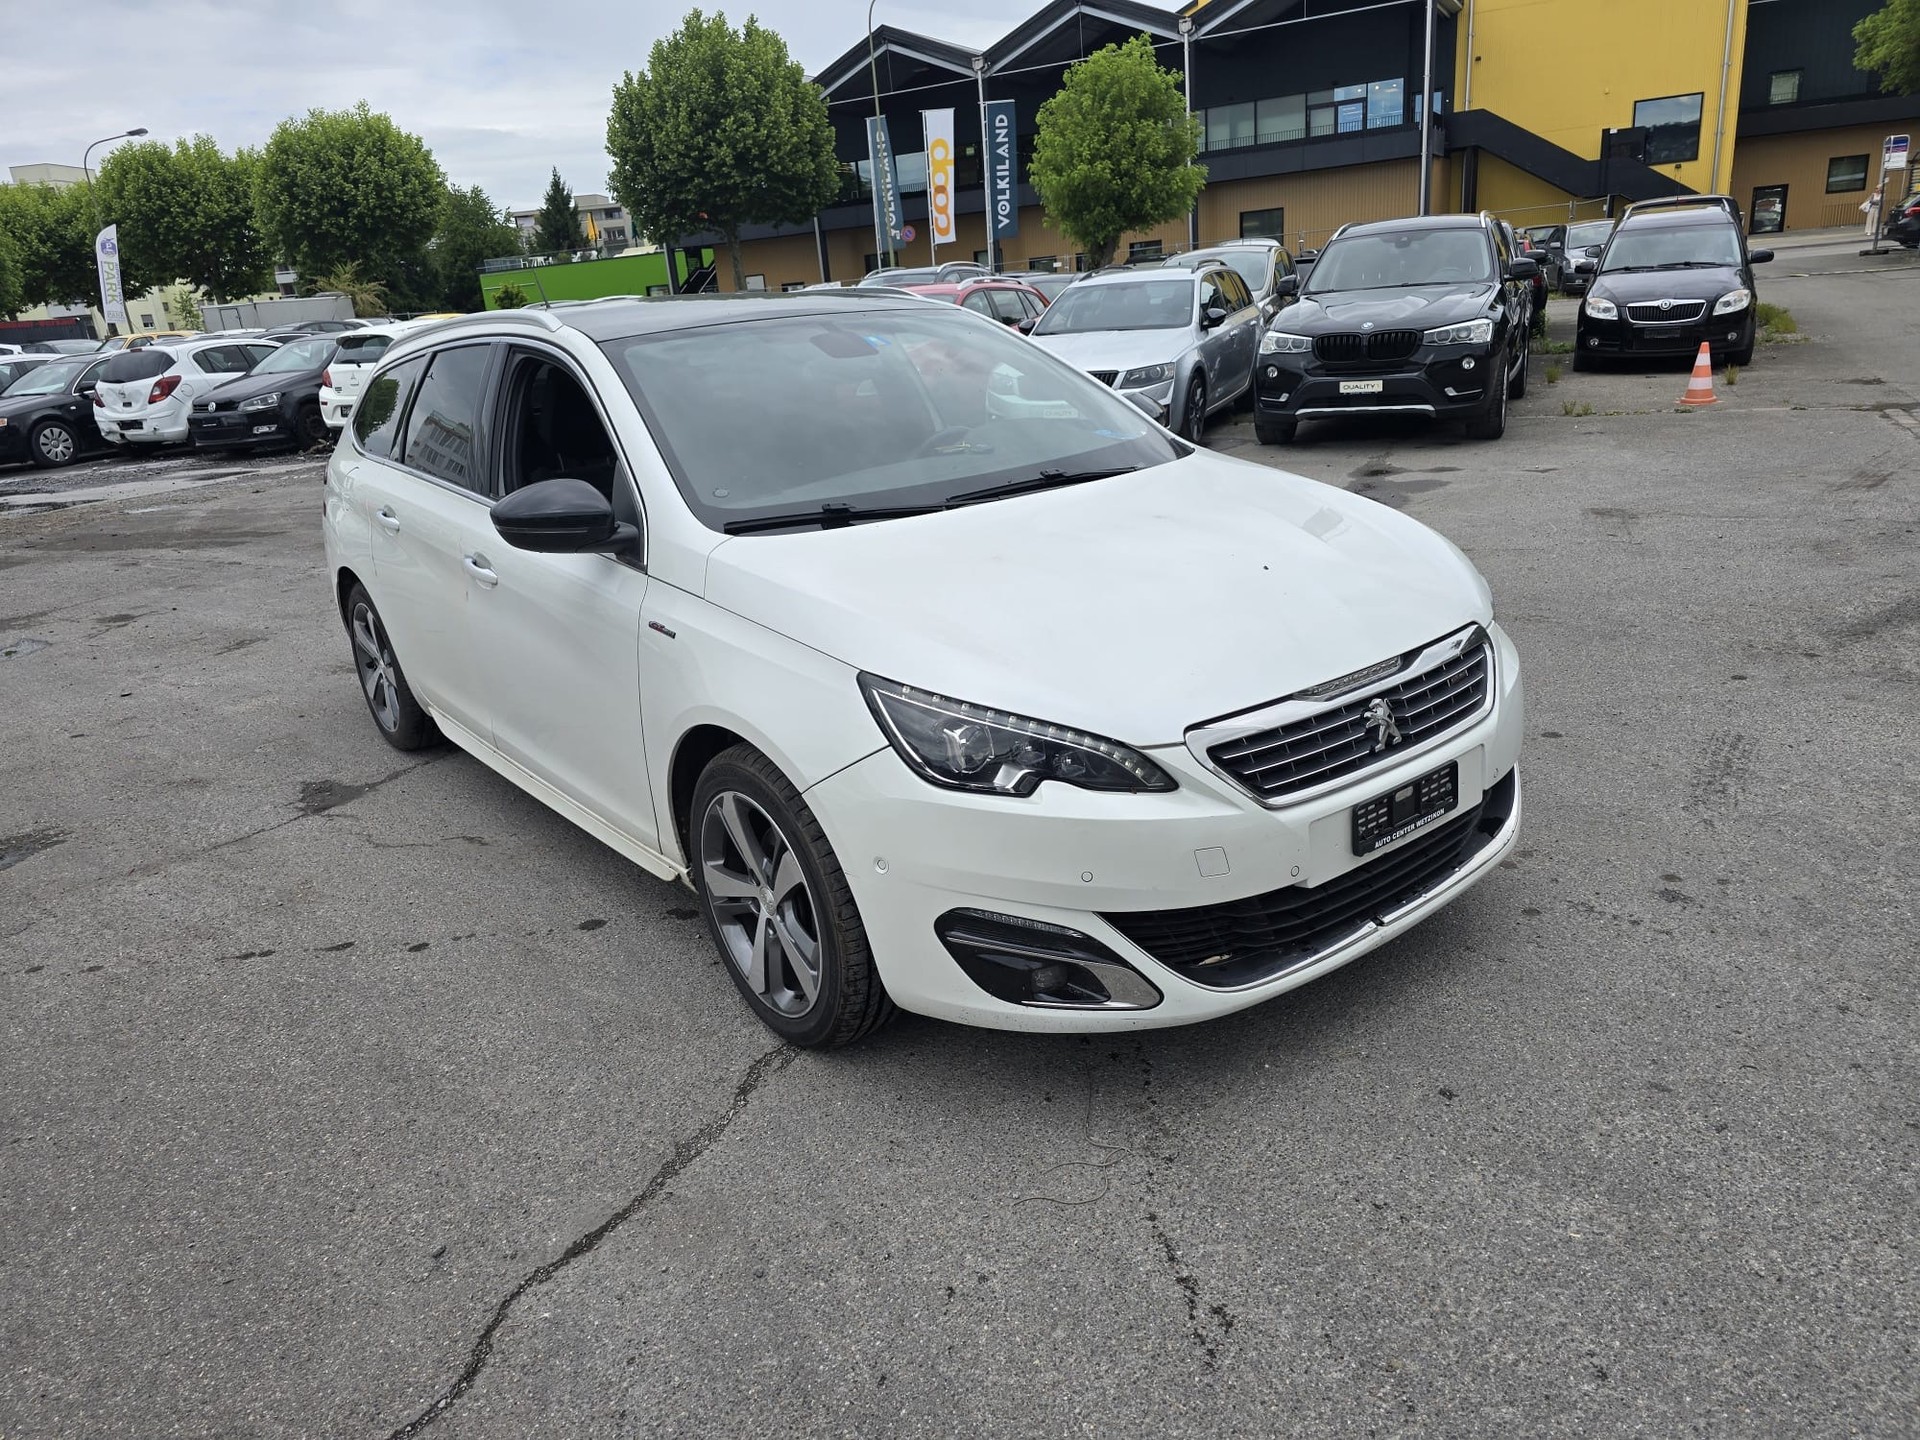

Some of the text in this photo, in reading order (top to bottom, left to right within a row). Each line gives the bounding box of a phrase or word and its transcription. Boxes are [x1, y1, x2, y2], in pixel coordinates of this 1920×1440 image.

[929, 138, 955, 237] coop
[995, 114, 1011, 229] VOLKILAND
[103, 261, 118, 304] PARK
[1374, 807, 1445, 849] AUTO CENTER WETZIKON
